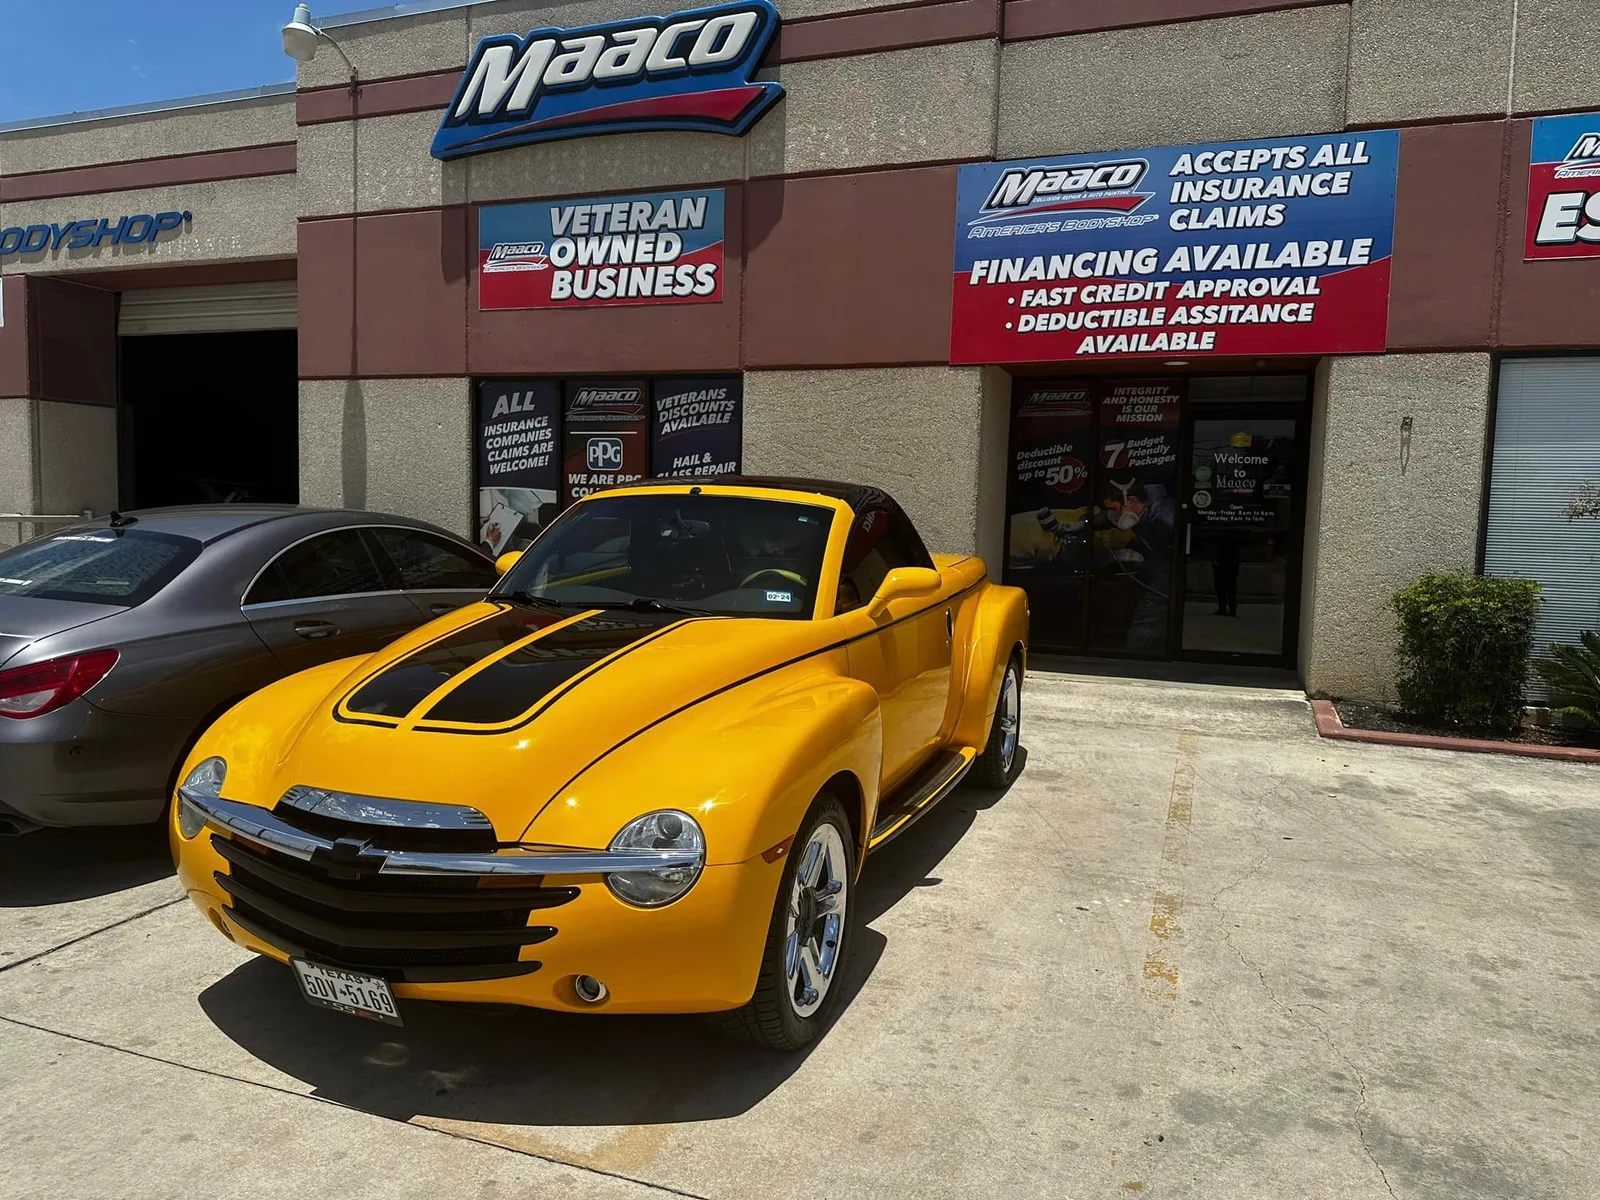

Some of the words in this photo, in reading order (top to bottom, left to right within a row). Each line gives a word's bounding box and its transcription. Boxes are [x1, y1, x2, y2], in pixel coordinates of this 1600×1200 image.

[455, 12, 757, 118] Maaco
[1169, 145, 1306, 177] ACCEPTS
[1310, 141, 1370, 168] ALL
[995, 164, 1141, 207] Maaco
[1169, 172, 1351, 204] INSURANCE
[550, 196, 708, 236] VETERAN
[1169, 204, 1285, 231] CLAIMS
[968, 221, 1061, 239] AMERICA'S
[491, 244, 542, 259] Maaco
[550, 232, 682, 267] OWNED
[969, 247, 1158, 285] FINANCING
[1164, 238, 1374, 273] AVAILABLE
[551, 264, 717, 299] BUSINESS
[1020, 285, 1077, 308] FAST
[1080, 281, 1170, 304] CREDIT
[1176, 276, 1321, 299] APPROVAL
[1017, 308, 1165, 332] DEDUCTIBLE
[1169, 302, 1314, 326] ASSITANCE
[1076, 331, 1216, 355] AVAILABLE
[575, 391, 638, 406] Maaco
[656, 388, 727, 411] VETERANS
[1028, 392, 1087, 405] Maaco
[1102, 396, 1129, 405] AND
[1130, 395, 1180, 404] HONESTY
[1113, 386, 1170, 396] INTEGRITY
[491, 391, 535, 419] ALL
[659, 400, 736, 423] DISCOUNTS
[1121, 405, 1130, 413] IS
[1131, 405, 1158, 413] OUR
[484, 415, 548, 437] INSURANCE
[661, 412, 732, 435] AVAILABLE
[1116, 414, 1162, 422] MISSION
[486, 428, 552, 449] COMPANIES
[1126, 436, 1164, 449] Budget
[487, 445, 529, 462] CLAIMS
[530, 441, 554, 455] ARE
[590, 442, 621, 467] PPG
[673, 454, 700, 468] HAIL
[702, 452, 712, 463] &
[1016, 443, 1073, 460] Deductible
[1104, 443, 1125, 469] 7
[1127, 445, 1170, 459] Friendly
[1128, 453, 1176, 467] Packages
[1214, 453, 1268, 464] Welcome
[489, 455, 549, 474] WELCOME!
[694, 461, 736, 475] REPAIR
[1017, 455, 1062, 470] discount
[568, 474, 588, 484] WE
[588, 474, 614, 485] ARE
[1018, 472, 1032, 481] up
[1034, 469, 1045, 478] to
[1045, 465, 1088, 486] 50%
[1216, 474, 1256, 488] Maaco
[1234, 469, 1246, 478] to
